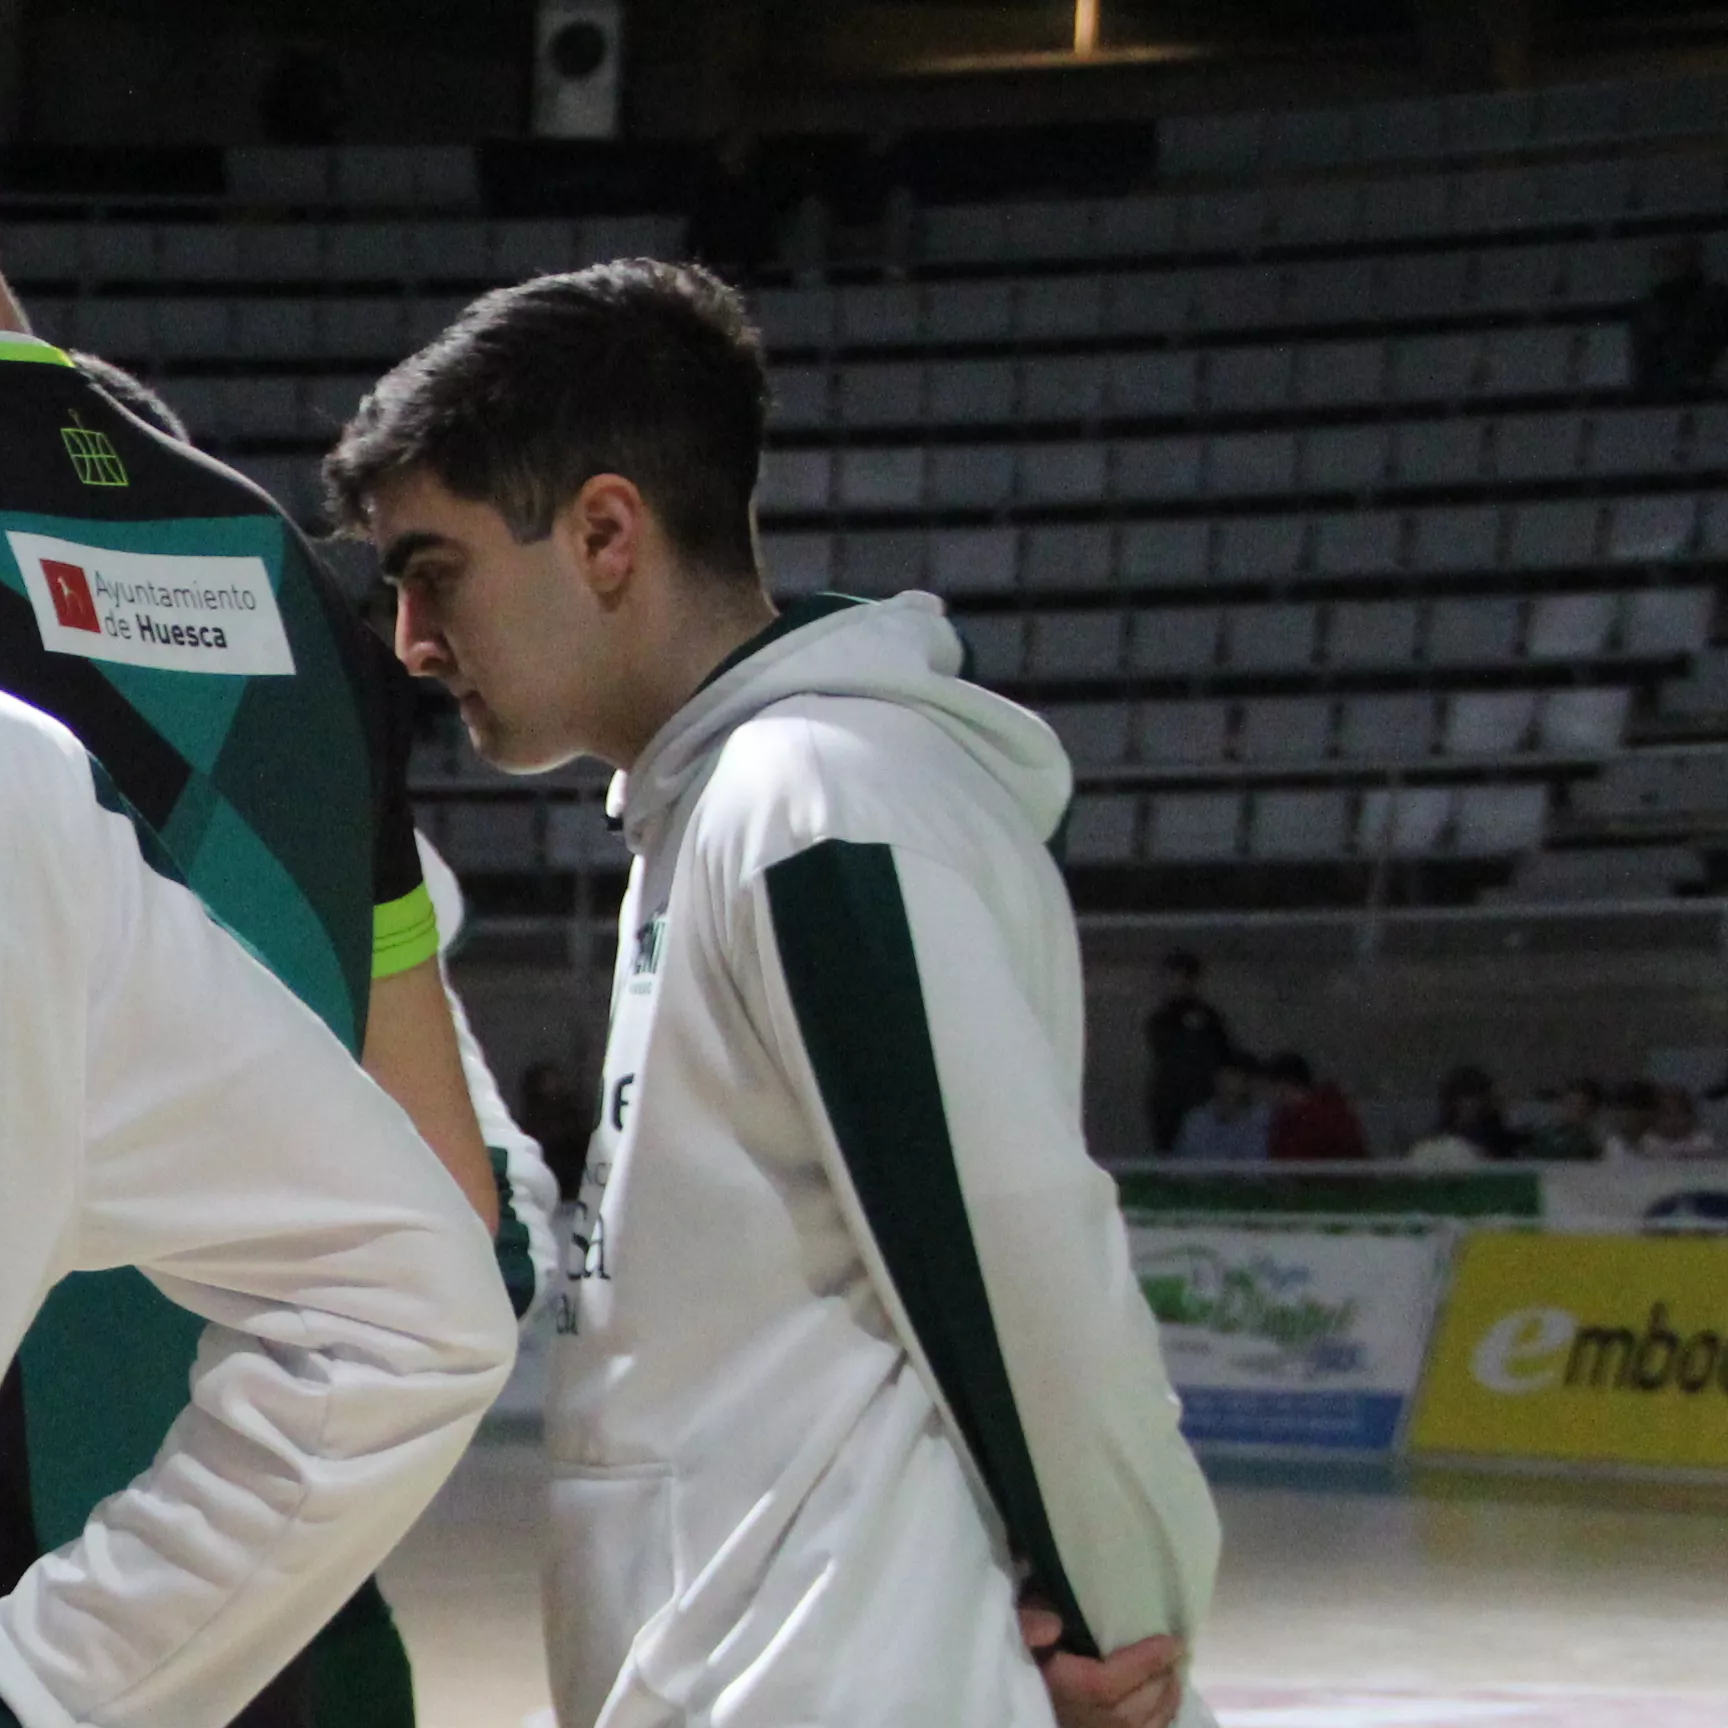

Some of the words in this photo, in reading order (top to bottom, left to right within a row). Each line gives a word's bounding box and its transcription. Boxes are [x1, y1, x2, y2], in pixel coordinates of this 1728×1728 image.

[95, 570, 257, 611] Ayuntamiento
[104, 610, 132, 640] de
[135, 613, 228, 649] Huesca
